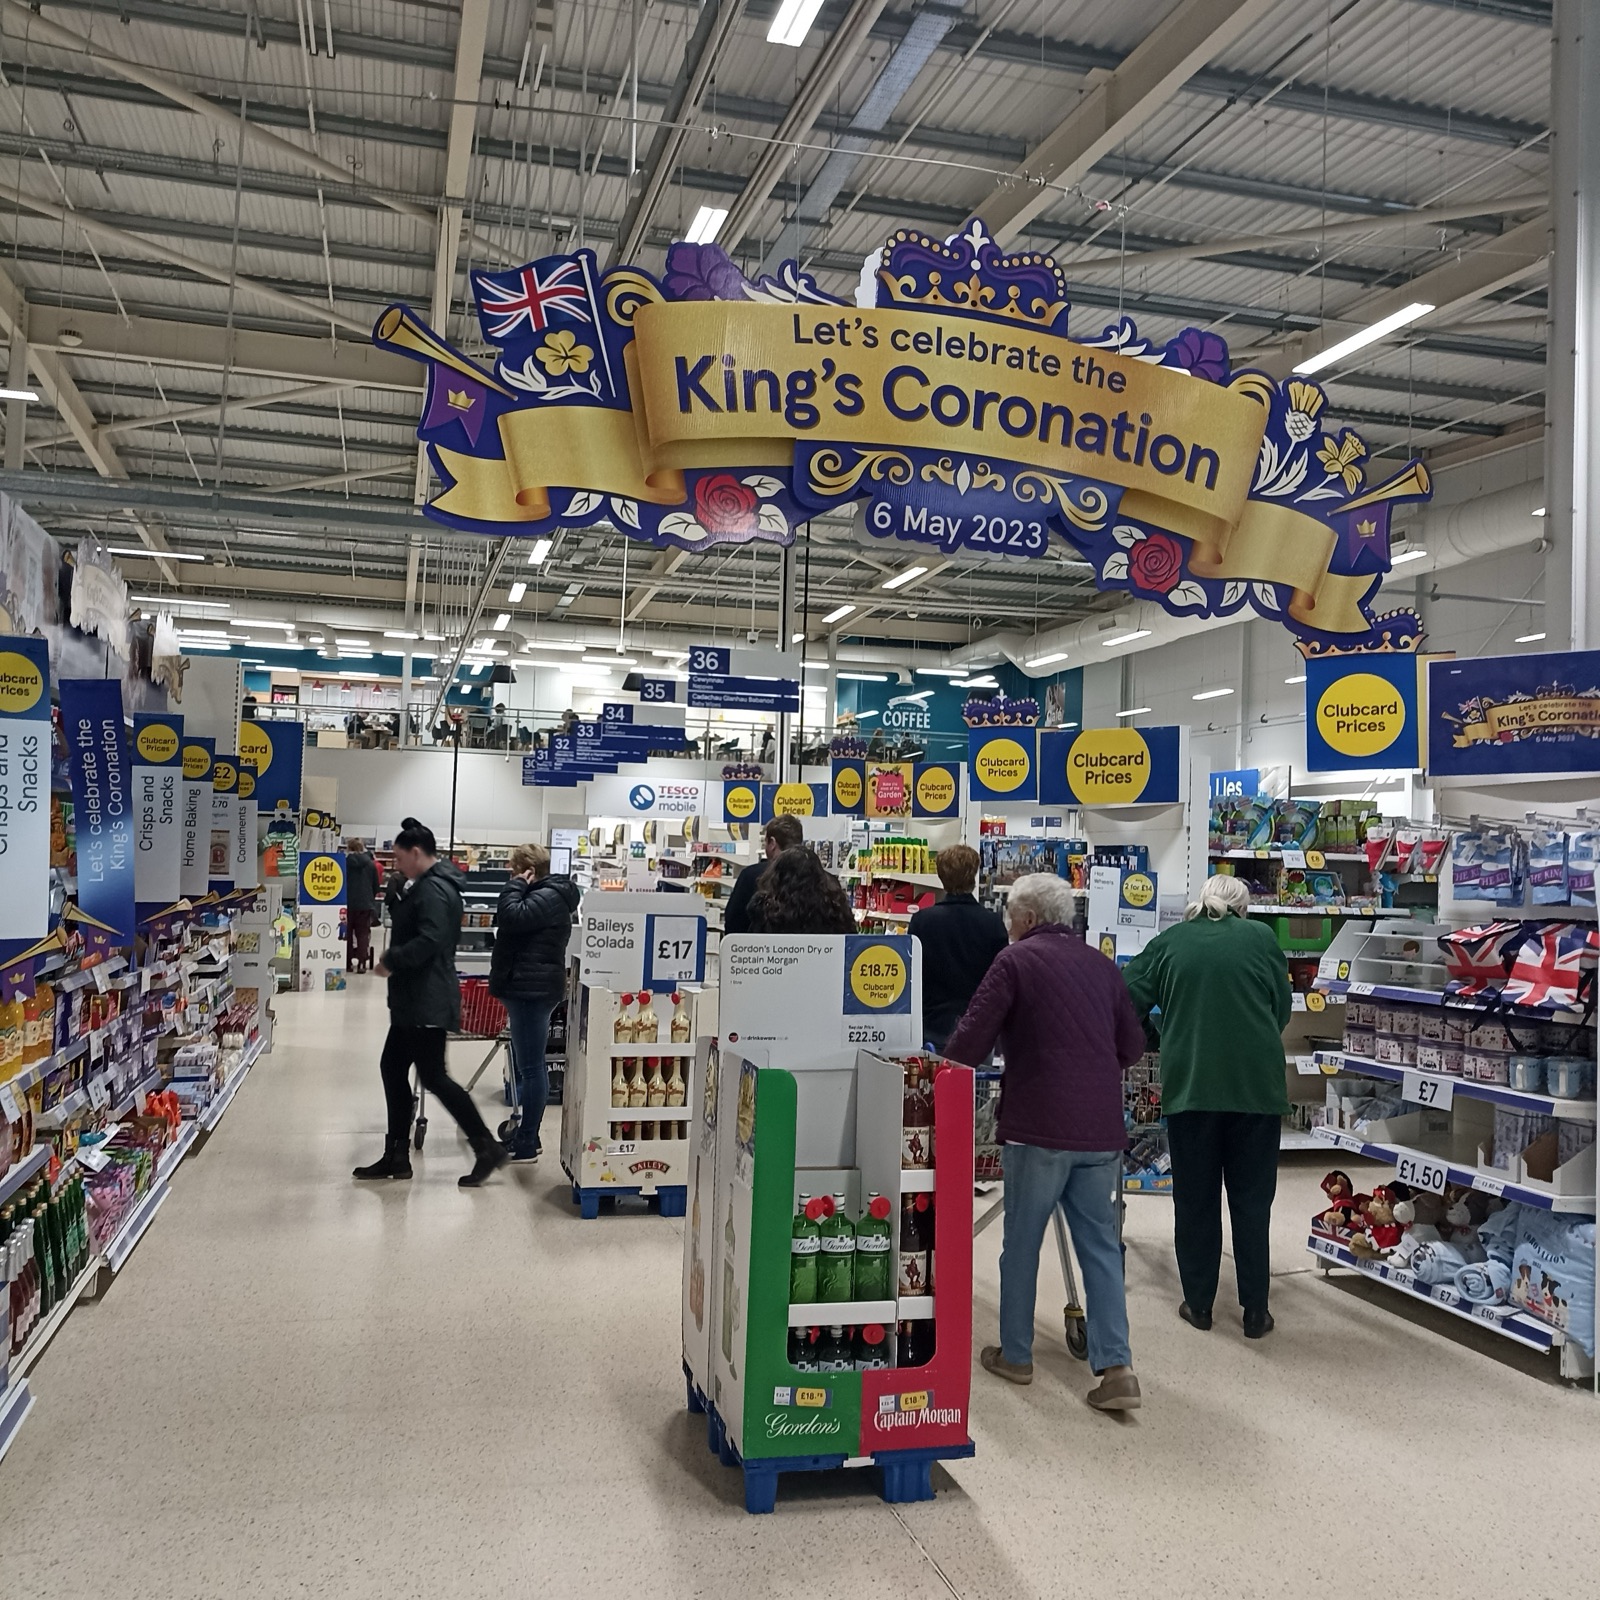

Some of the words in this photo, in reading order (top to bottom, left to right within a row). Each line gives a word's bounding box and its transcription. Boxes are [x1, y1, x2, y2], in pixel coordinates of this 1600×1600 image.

[794, 314, 878, 348] Let's
[890, 326, 1061, 378] celebrate
[1072, 354, 1127, 393] the
[674, 354, 864, 430] King's
[881, 364, 1221, 493] Coronation
[873, 502, 891, 529] 6
[904, 505, 962, 545] May
[970, 516, 1042, 548] 2023
[693, 651, 719, 670] 36
[0, 686, 30, 697] rices
[644, 683, 665, 699] 35
[605, 706, 625, 720] 34
[1323, 700, 1397, 720] Clubcard
[882, 710, 931, 729] COFFEE
[1497, 713, 1535, 728] King's
[1537, 710, 1600, 721] Coronati
[77, 718, 94, 748] the
[577, 724, 594, 738] 33
[1335, 720, 1385, 735] Prices
[140, 737, 175, 746] Clubcard
[554, 738, 570, 750] 32
[146, 745, 170, 753] Prices
[239, 744, 268, 756] card
[536, 750, 547, 760] 31
[183, 756, 209, 765] lubcard
[980, 756, 1026, 769] Clubcard
[1073, 752, 1144, 769] Clubcard
[18, 735, 38, 813] Snacks
[101, 719, 123, 816] Coronation
[213, 766, 231, 779] £2
[986, 767, 1018, 778] Prices
[1085, 770, 1132, 786] Prices
[141, 775, 155, 801] and
[658, 785, 698, 797] TESCO
[836, 781, 860, 789] Clubcard
[920, 783, 952, 791] Clubcard
[82, 752, 102, 836] celebrate
[159, 775, 174, 824] Snacks
[777, 796, 811, 805] Clubcard
[878, 790, 902, 798] Garden
[184, 788, 201, 828] Baking
[212, 800, 228, 808] 2.70
[658, 800, 697, 813] mobile
[782, 806, 805, 815] Prices
[139, 805, 156, 851] Crisps
[237, 805, 247, 863] Condiments
[109, 820, 129, 870] King's
[182, 829, 195, 867] Home
[88, 840, 104, 882] Let's
[313, 861, 334, 872] Half
[311, 872, 337, 883] Price
[587, 917, 634, 935] Baileys
[585, 935, 634, 949] Colada
[306, 949, 318, 959] All
[320, 949, 342, 962] Toys
[658, 940, 693, 960] £17
[730, 943, 770, 954] Gordon's
[772, 945, 805, 955] London
[807, 945, 822, 956] Dry
[730, 954, 765, 965] Captain
[767, 956, 799, 967] Morgan
[677, 970, 692, 979] £17
[730, 966, 760, 976] Spiced
[761, 966, 783, 976] Gold
[860, 963, 898, 977] £18.75
[863, 983, 895, 991] Clubcard
[870, 991, 888, 999] Price
[849, 1031, 886, 1043] £22.50
[1330, 1056, 1339, 1067] £7
[1418, 1080, 1439, 1103] £7
[619, 1144, 636, 1153] £17
[631, 1160, 668, 1172] BAILEYS
[1399, 1160, 1444, 1190] £1.50
[1325, 1245, 1334, 1255] £8
[1395, 1273, 1407, 1284] £12
[1440, 1290, 1452, 1302] £7
[1481, 1308, 1495, 1320] £10
[764, 1412, 841, 1439] Gordon's
[873, 1411, 917, 1432] Captain
[915, 1407, 961, 1428] Morgan
